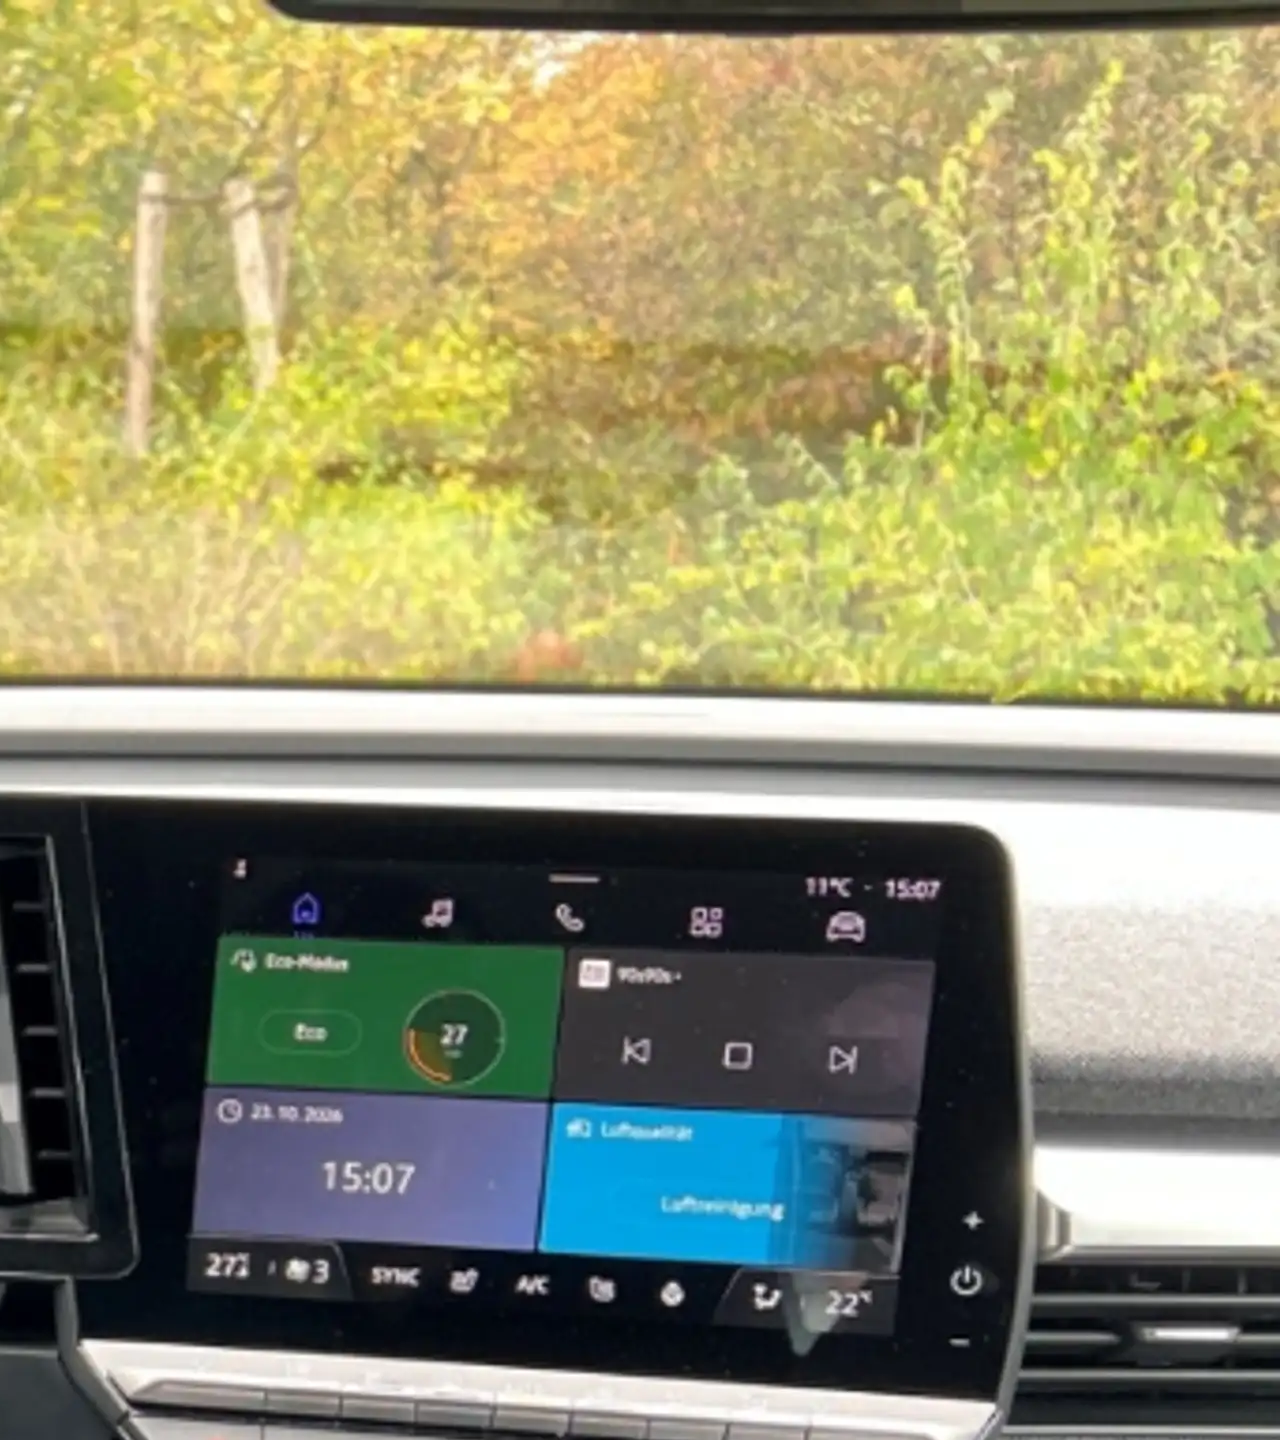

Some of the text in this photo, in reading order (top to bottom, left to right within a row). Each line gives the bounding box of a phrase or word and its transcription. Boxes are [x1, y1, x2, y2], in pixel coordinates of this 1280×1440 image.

[885, 879, 940, 899] 15:07
[294, 1022, 327, 1042] Eco
[441, 1024, 468, 1046] 27
[321, 1161, 416, 1195] 15:07
[312, 1258, 330, 1284] 3
[515, 1275, 550, 1296] A/C
